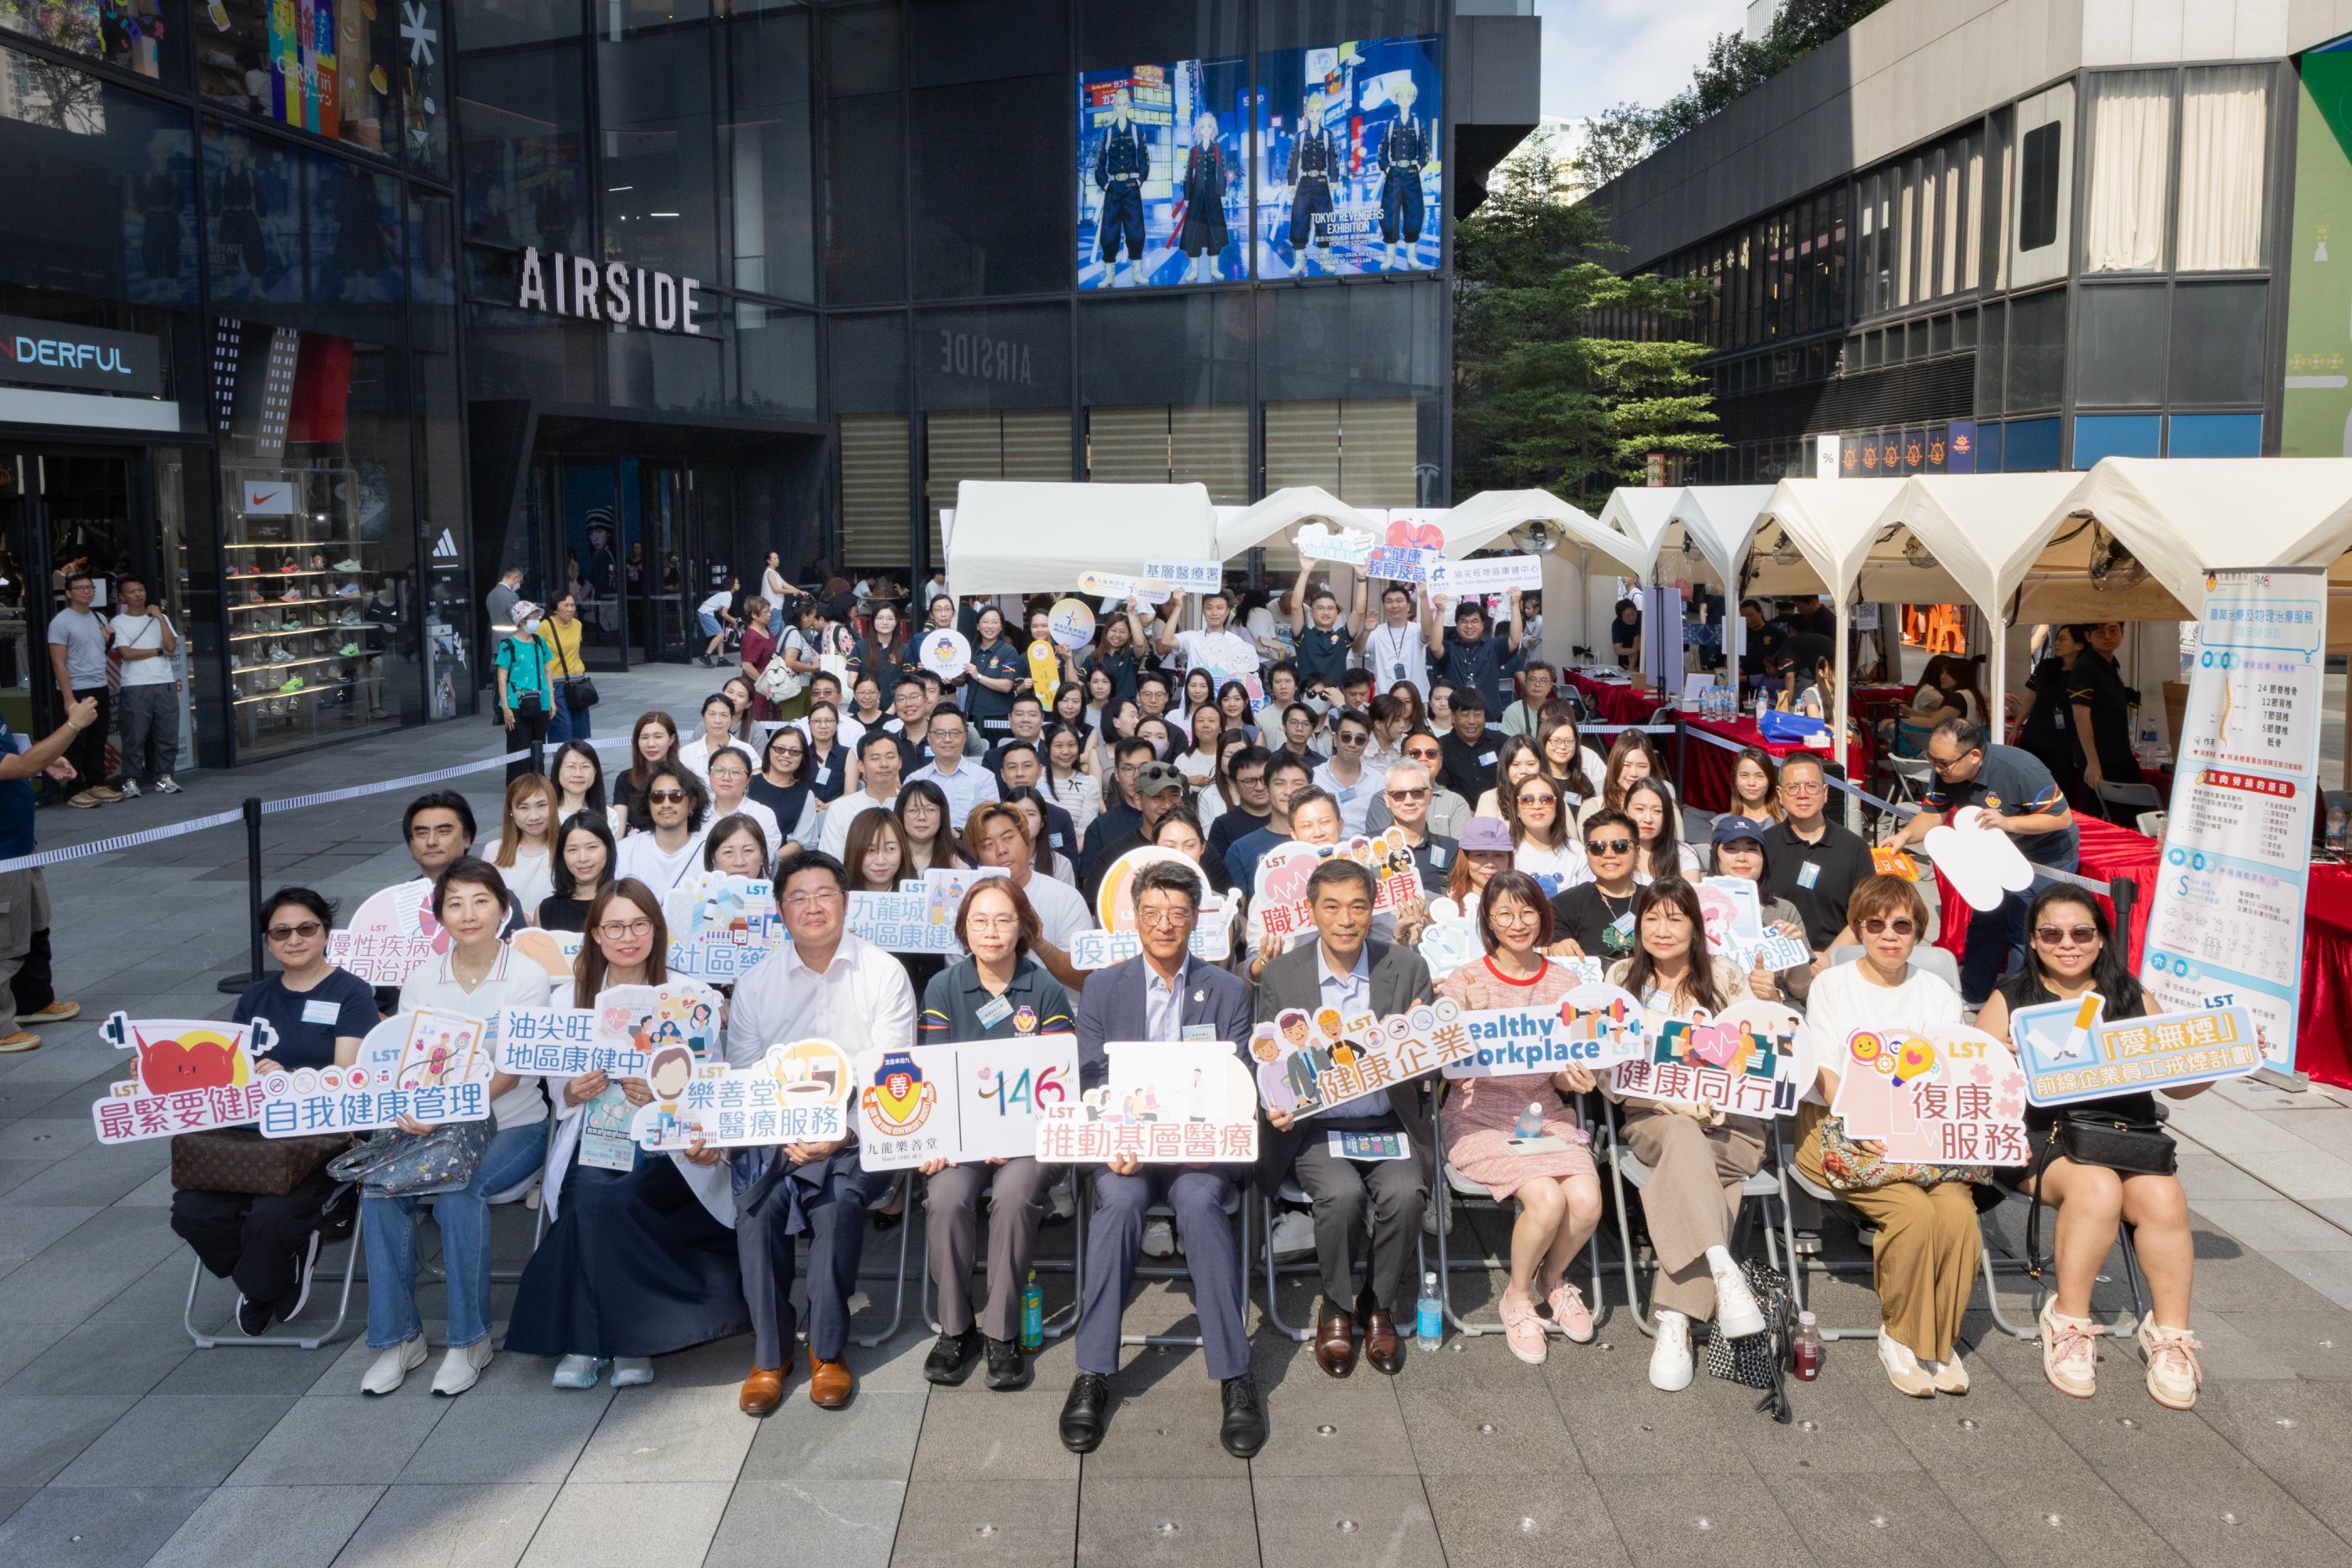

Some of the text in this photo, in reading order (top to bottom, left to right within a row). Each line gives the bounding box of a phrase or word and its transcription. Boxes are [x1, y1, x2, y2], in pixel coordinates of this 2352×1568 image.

[1310, 208, 1384, 223] TOKYO REVENGERS
[1327, 221, 1369, 234] EXHIBITION
[519, 245, 701, 334] AIRSIDE
[1392, 548, 1423, 564] 健康
[1147, 564, 1219, 581] 基層醫療署
[1454, 564, 1539, 579] 油尖旺地區康健中心
[2210, 608, 2314, 625] 職業治療及物理治療服務
[2258, 684, 2267, 693] 24
[2204, 737, 2215, 747] 作用
[357, 781, 388, 795] AIRSIDE
[2208, 773, 2288, 794] 肌肉勞損的原因
[183, 816, 223, 832] AIRSIDE
[1265, 855, 1287, 869] LST
[746, 884, 769, 895] LST
[905, 883, 927, 893] LST
[852, 894, 926, 922] 九龍城
[1121, 910, 1136, 920] LS
[328, 933, 433, 957] 慢性疾病
[1074, 926, 1207, 965] 疫苗種
[2204, 993, 2234, 1009] LST
[508, 1010, 595, 1042] 油尖旺
[1346, 1015, 1373, 1033] LST
[1468, 1013, 1555, 1043] ealthy
[372, 1049, 402, 1063] LST
[1612, 1041, 1641, 1056] LST
[1948, 1041, 1987, 1058] LST
[505, 1042, 649, 1075] 地區康健中
[1317, 1022, 1473, 1105] 健康企業
[698, 1066, 726, 1079] LST
[2034, 1043, 2254, 1097] 前線企業員工戒煙計劃
[114, 1083, 139, 1098] LST
[688, 1078, 777, 1110] 樂善堂
[994, 1065, 1066, 1116] 146
[1616, 1059, 1772, 1112] 健康同行
[264, 1081, 484, 1133] 自我健康管理
[1910, 1082, 1994, 1120] 復康
[100, 1081, 266, 1139] 最緊要健康
[1048, 1106, 1075, 1119] LST
[718, 1105, 838, 1140] 醫療服務
[867, 1137, 938, 1156] 九龍樂善堂
[1042, 1123, 1253, 1159] 推動基層醫療
[1941, 1123, 2024, 1161] 服務
